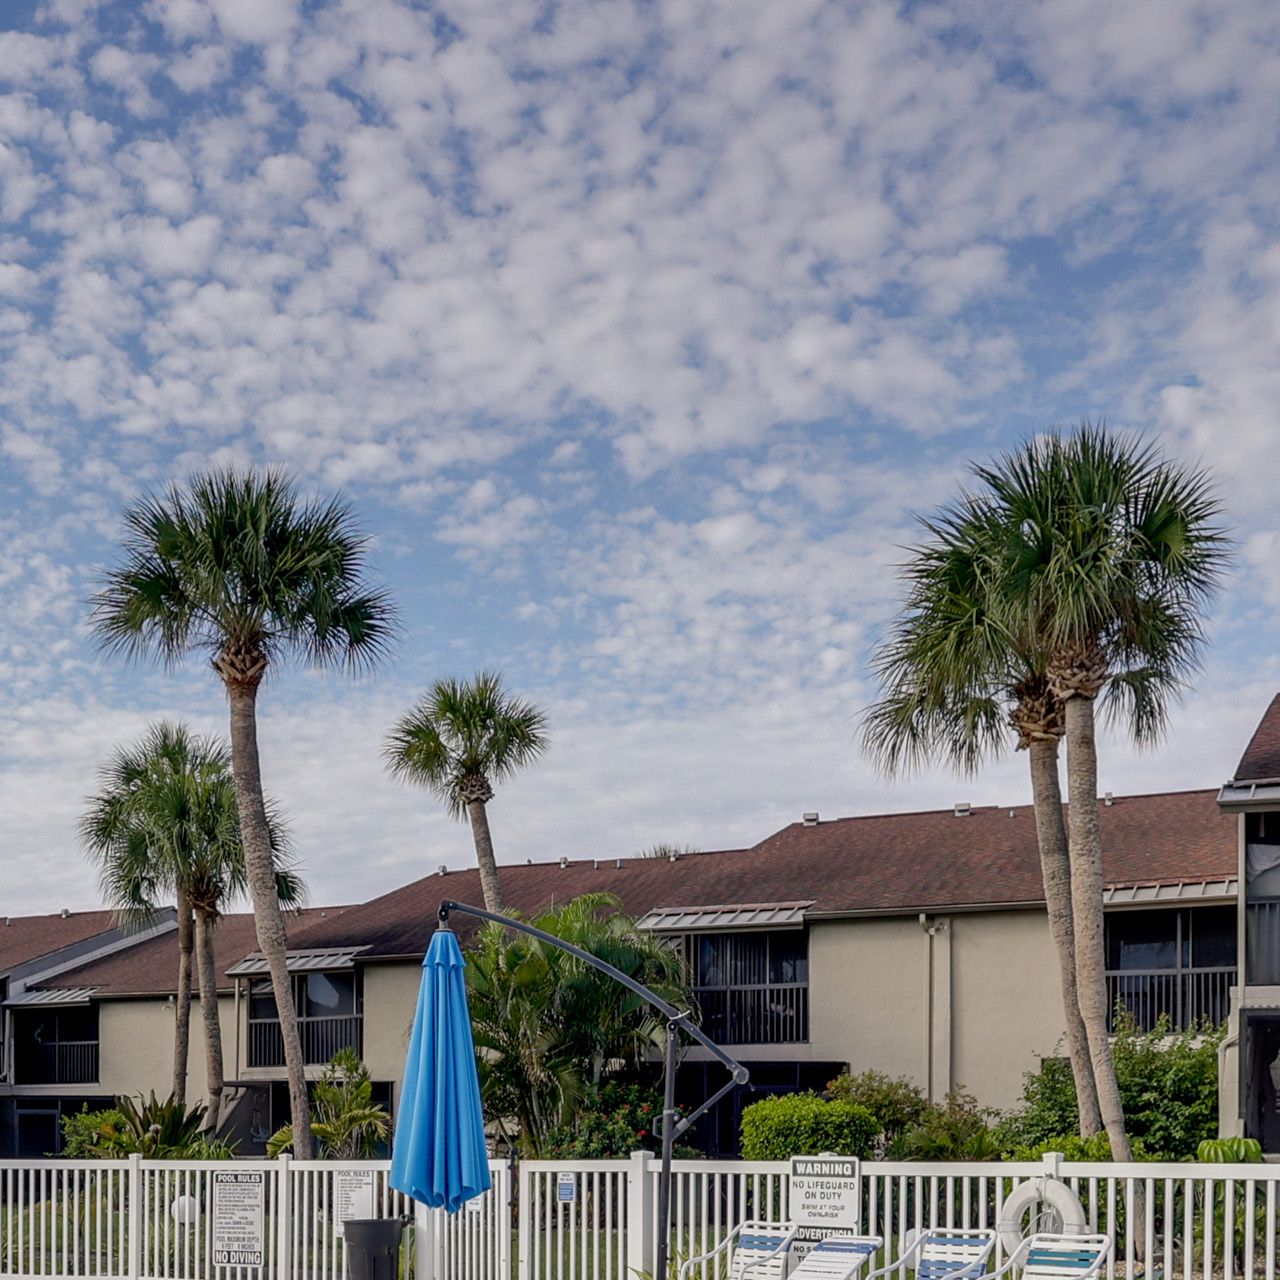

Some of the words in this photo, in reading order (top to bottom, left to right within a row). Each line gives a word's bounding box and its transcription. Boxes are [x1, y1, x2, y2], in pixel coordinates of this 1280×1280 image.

[796, 1162, 852, 1175] WARNING
[217, 1174, 236, 1182] POOL
[237, 1174, 260, 1182] RULES
[792, 1181, 805, 1189] NO
[807, 1181, 855, 1190] LIFEGUARD
[804, 1191, 817, 1200] ON
[819, 1192, 842, 1200] DUTY
[793, 1245, 805, 1253] NO
[215, 1251, 229, 1263] NO
[231, 1251, 261, 1264] DIVING
